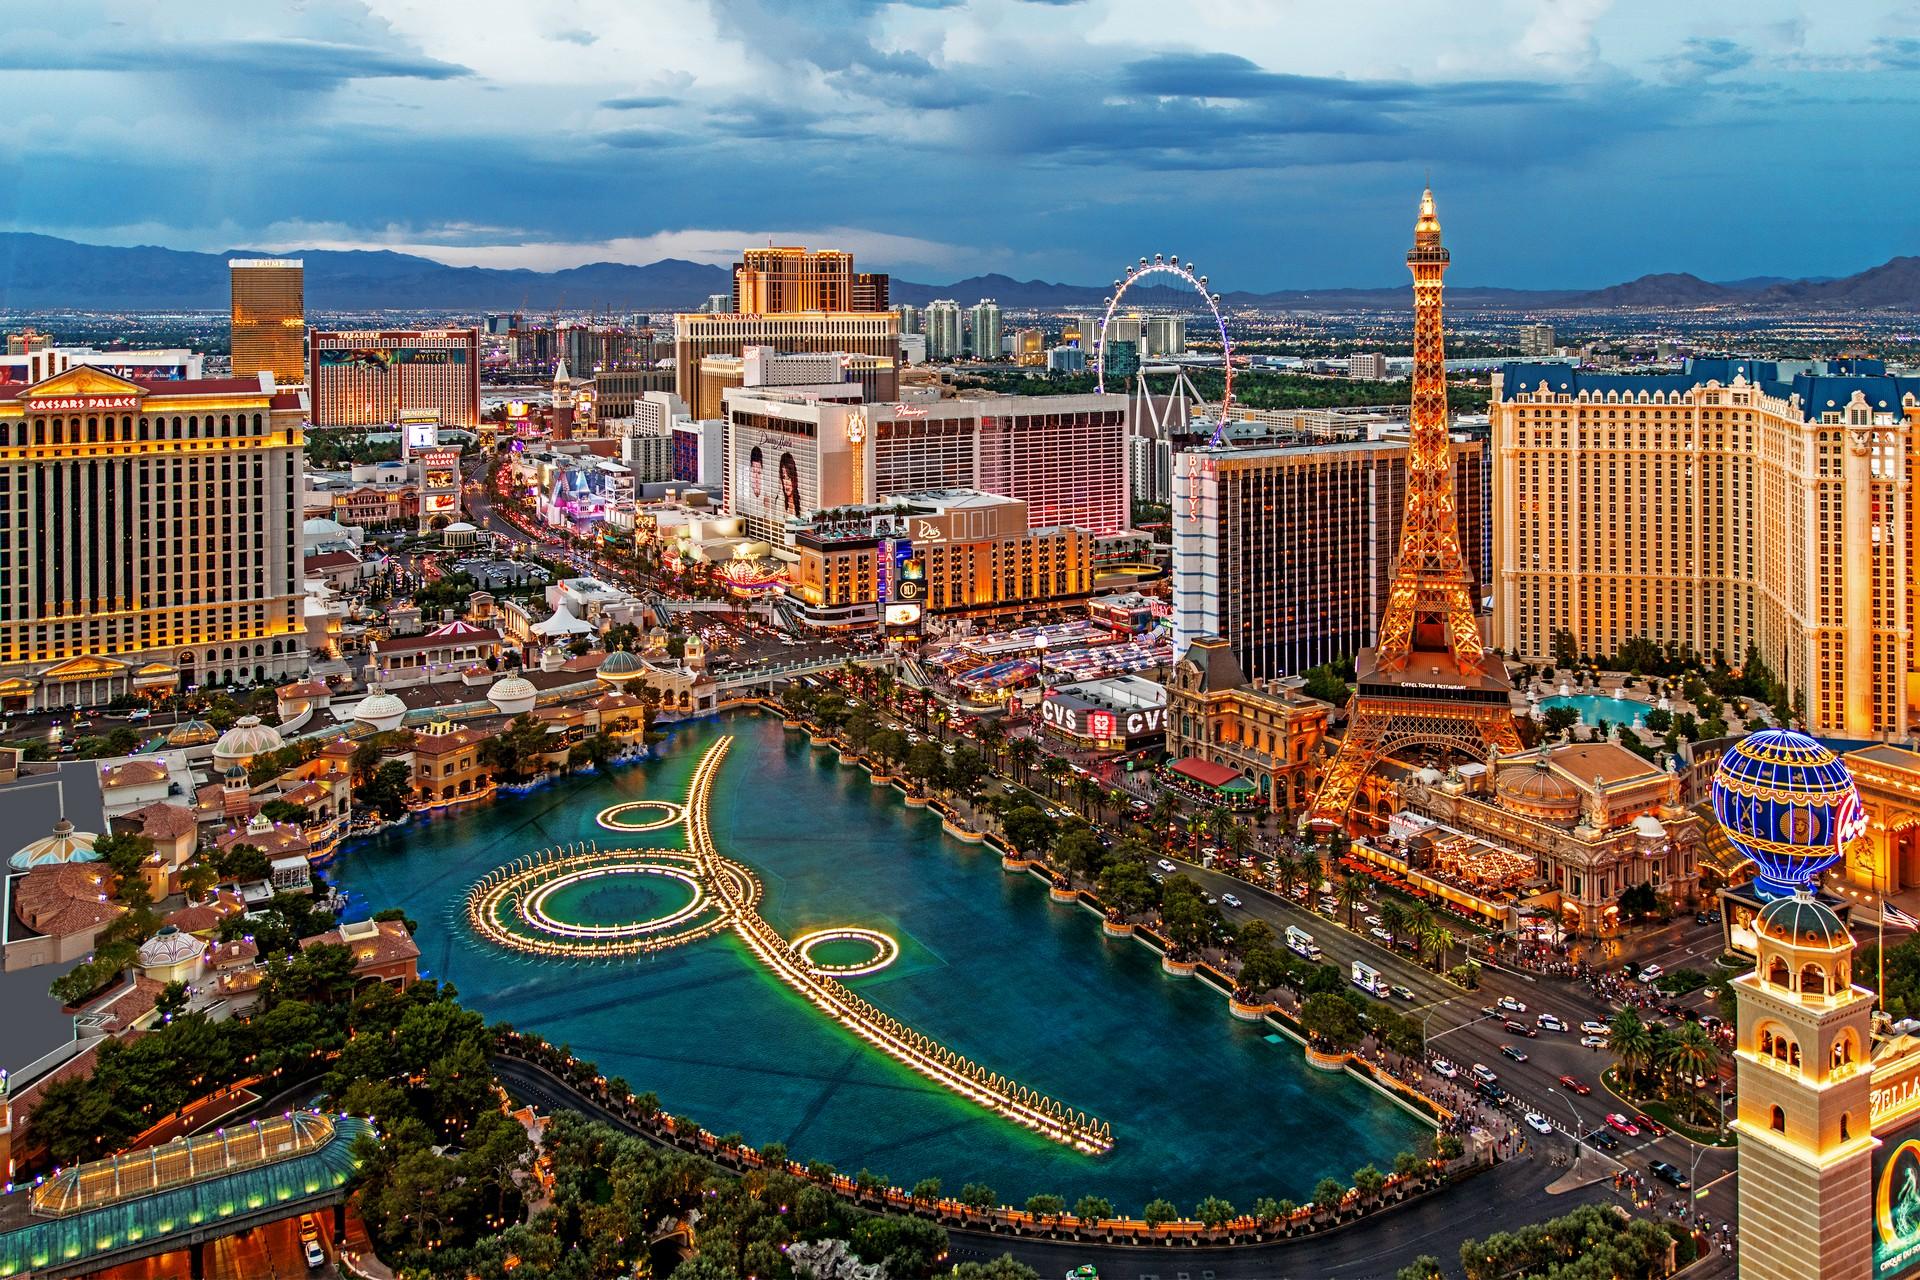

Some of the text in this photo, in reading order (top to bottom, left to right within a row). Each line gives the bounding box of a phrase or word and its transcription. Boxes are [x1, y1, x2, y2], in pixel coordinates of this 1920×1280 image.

[29, 397, 136, 410] CAESARS PALACE
[895, 404, 928, 417] Flamingo
[1188, 455, 1199, 522] BALLYS
[885, 543, 893, 596] BALLYS
[903, 585, 914, 595] BLT
[1042, 700, 1077, 730] CVS
[1880, 1253, 1903, 1271] CIRQUE
[1903, 1247, 1912, 1260] DU
